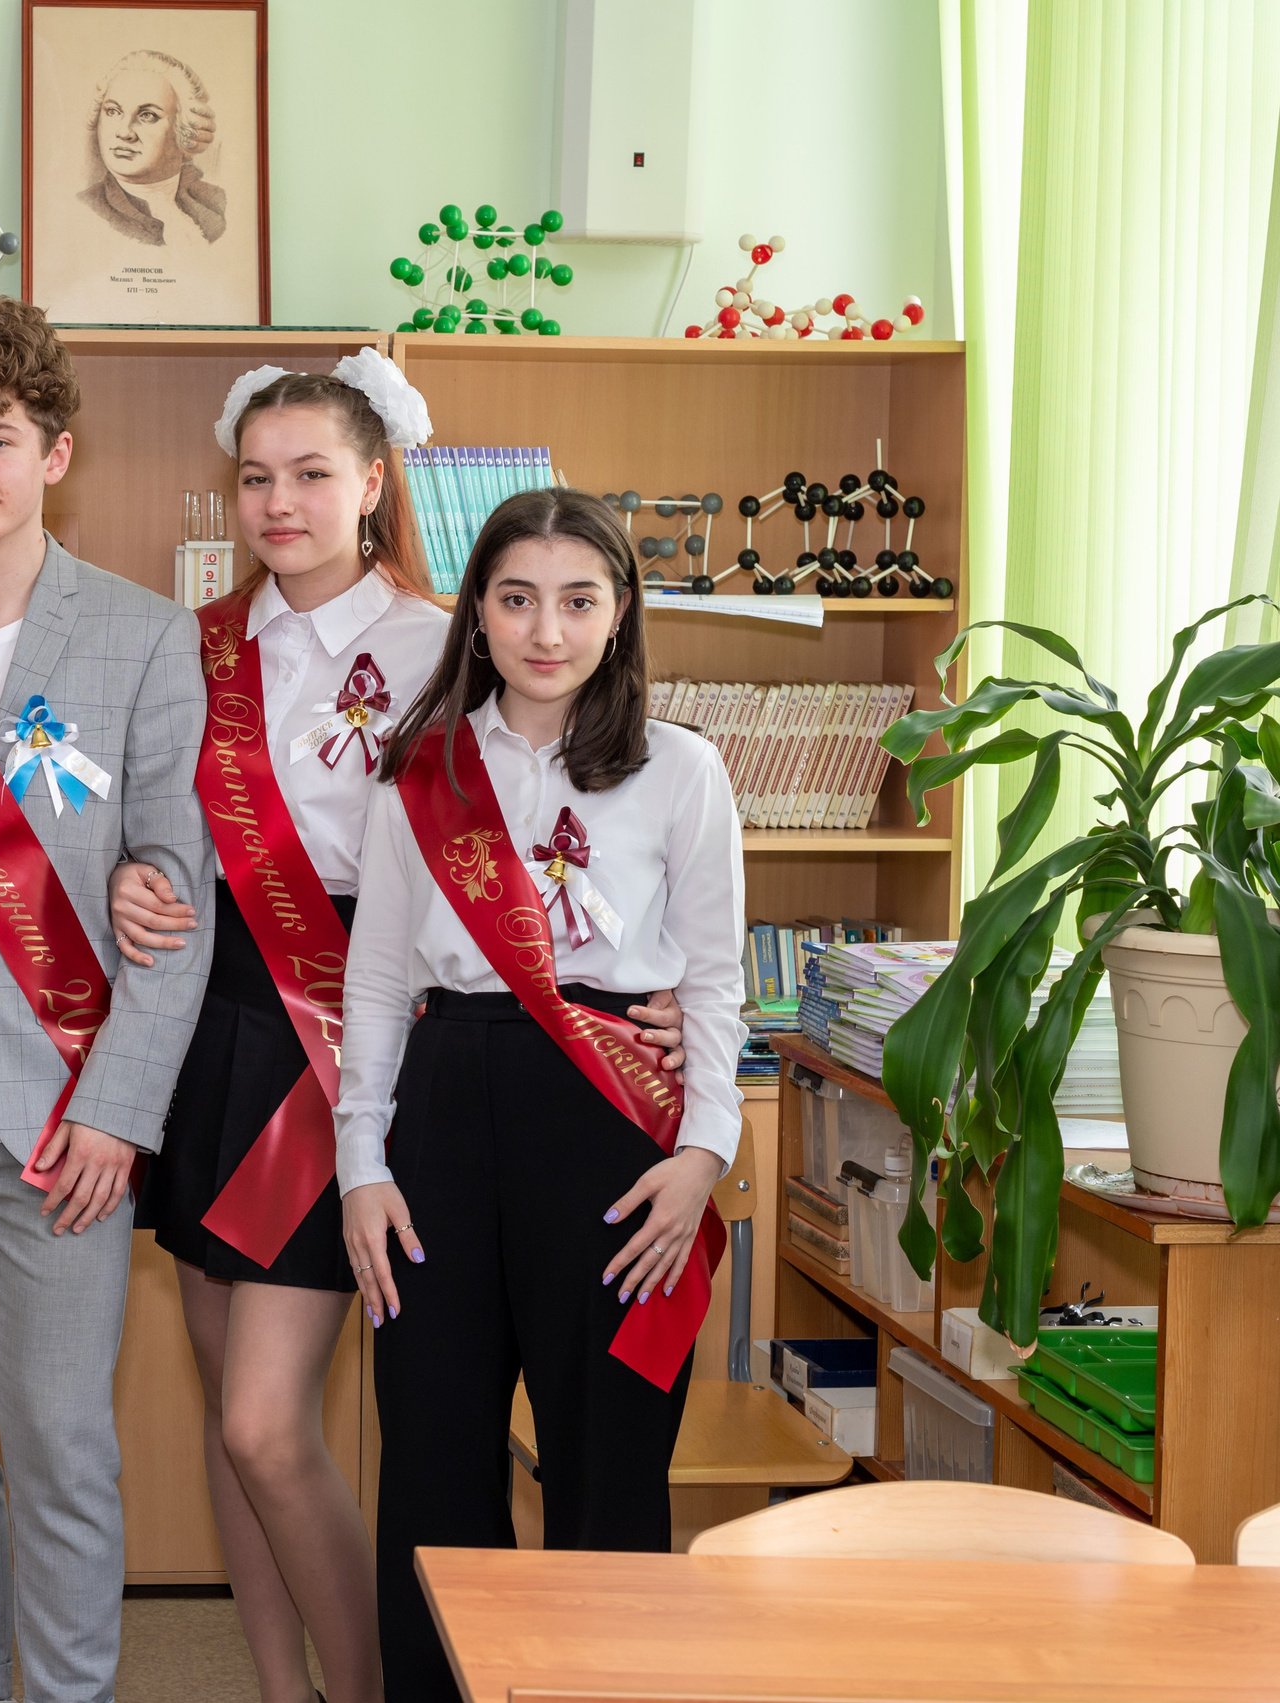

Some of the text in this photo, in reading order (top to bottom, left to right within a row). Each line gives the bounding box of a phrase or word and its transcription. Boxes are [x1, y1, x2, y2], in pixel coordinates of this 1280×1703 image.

[203, 553, 217, 563] 10
[206, 570, 214, 580] 9
[205, 587, 214, 597] 8
[295, 719, 334, 749] ВЫПУСК
[308, 731, 329, 750] 2022
[208, 692, 307, 936] Выпускник
[496, 906, 682, 1119] Выпускник
